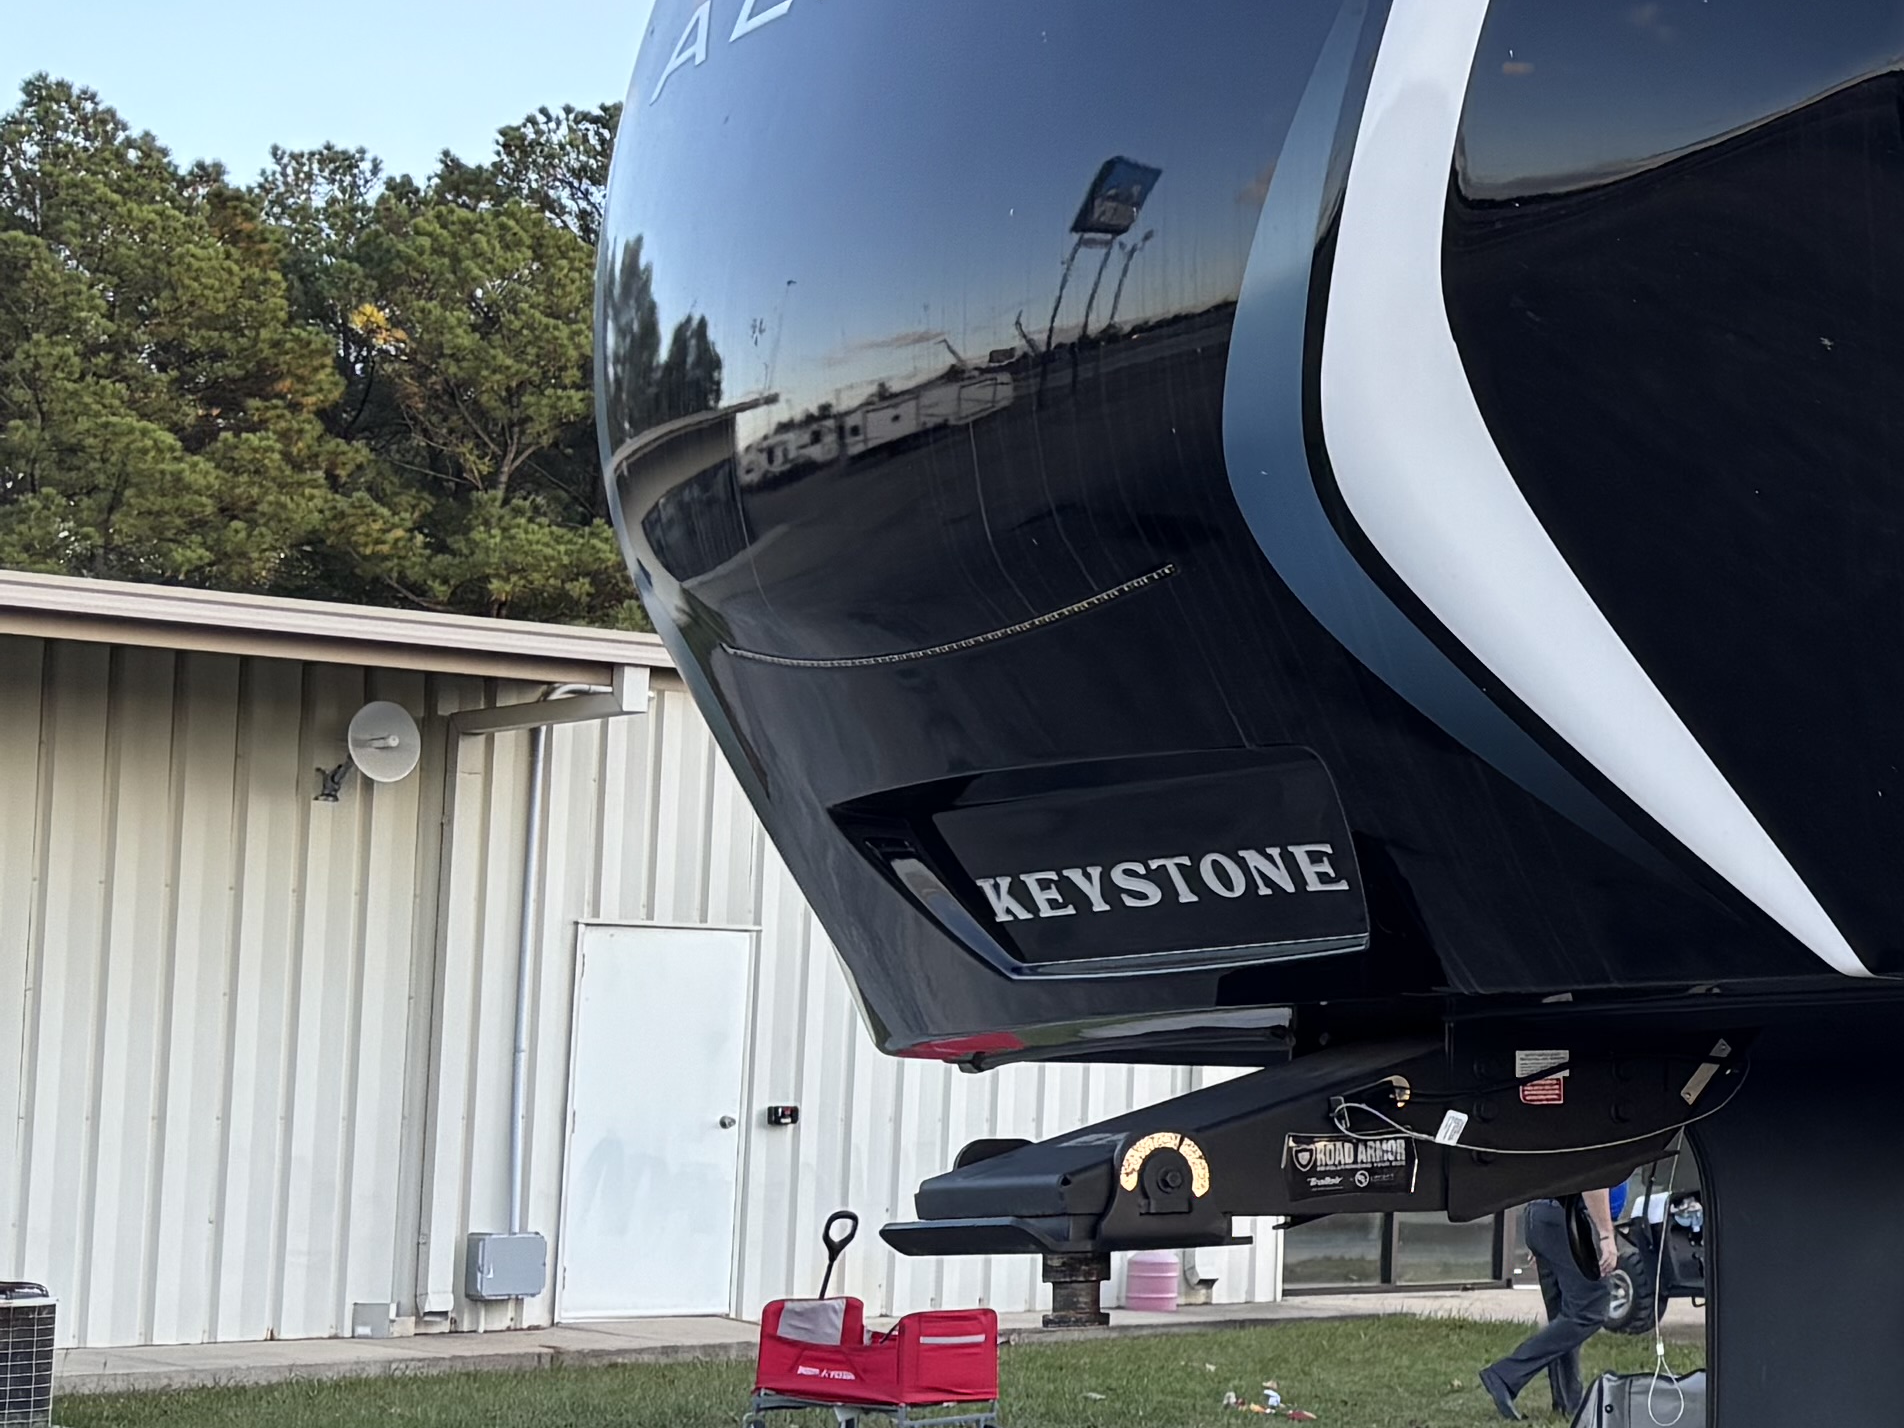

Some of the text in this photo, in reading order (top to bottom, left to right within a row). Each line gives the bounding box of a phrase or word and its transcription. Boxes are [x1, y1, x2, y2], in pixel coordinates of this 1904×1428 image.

[975, 842, 1350, 923] KEYSTONE
[1315, 1139, 1406, 1166] ROAD ARMOR
